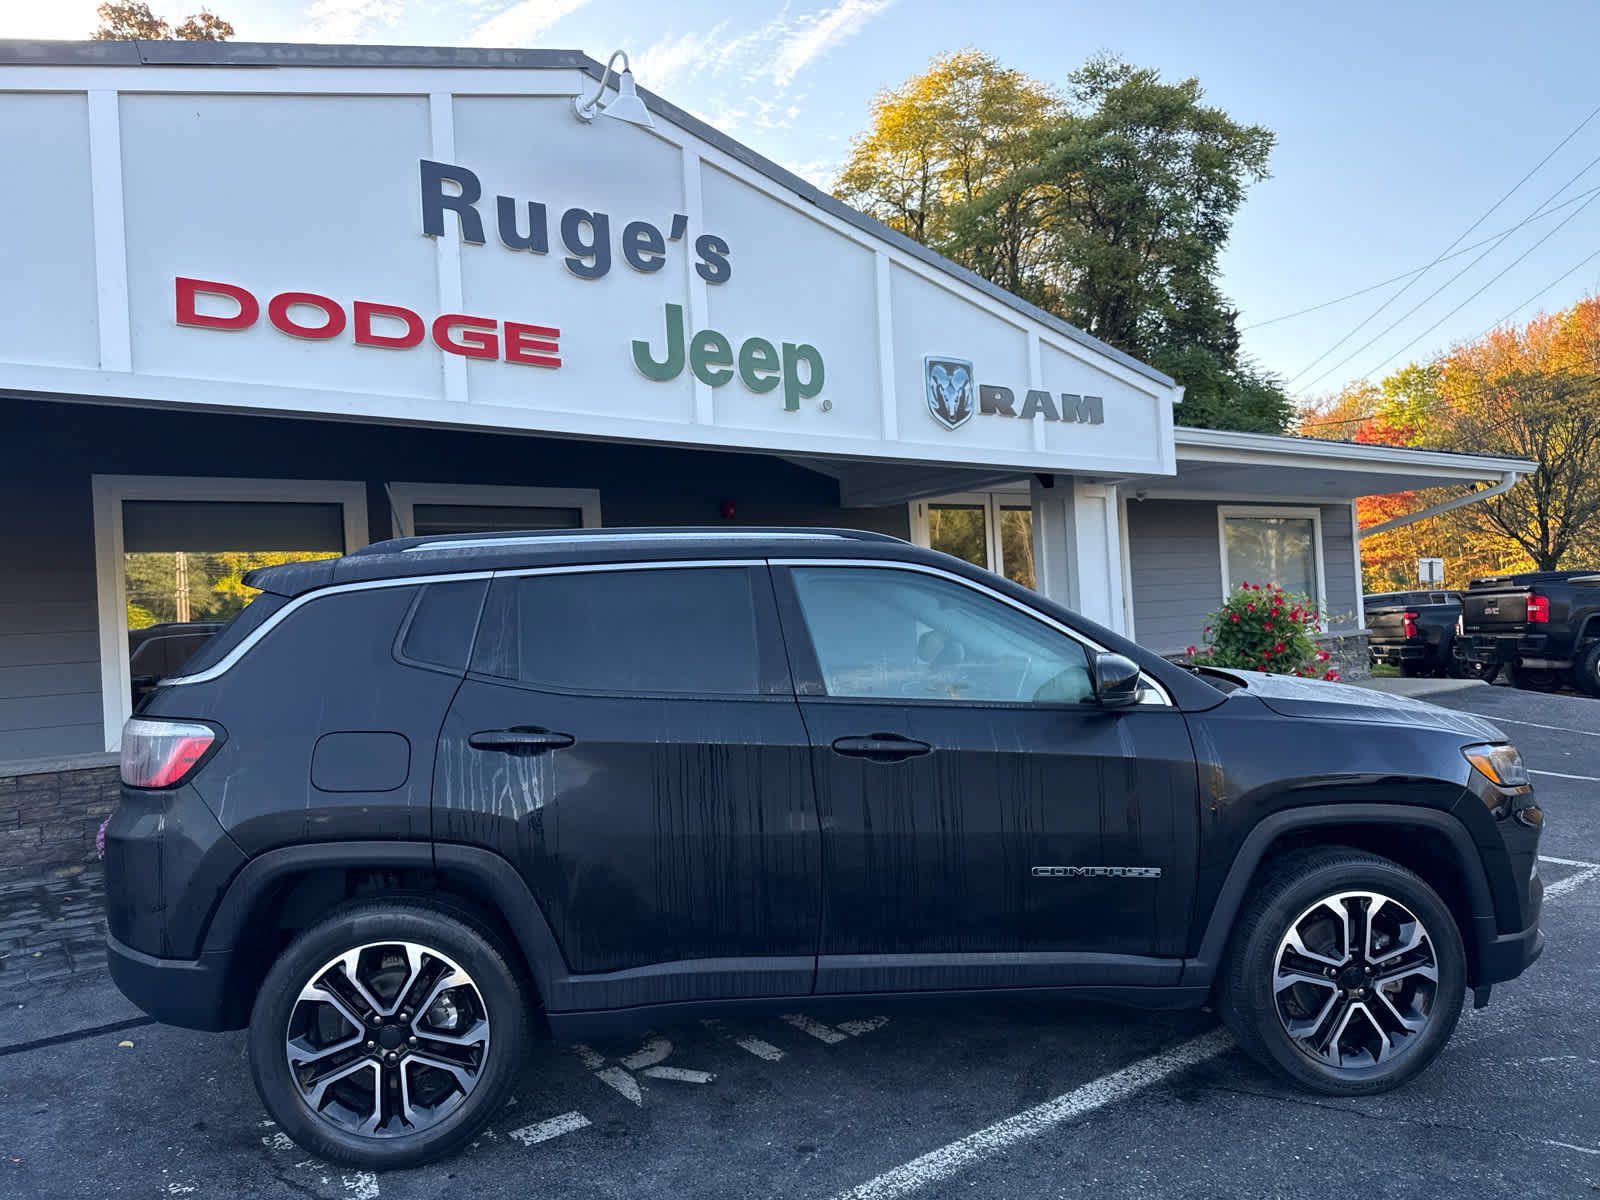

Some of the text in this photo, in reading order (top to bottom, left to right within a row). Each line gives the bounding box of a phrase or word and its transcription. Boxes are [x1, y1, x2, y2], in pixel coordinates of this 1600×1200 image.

[420, 159, 732, 284] Ruge's
[175, 276, 562, 369] DODGE
[632, 303, 825, 411] Jeep
[979, 384, 1104, 424] RAM
[1031, 866, 1162, 878] COMPASS
